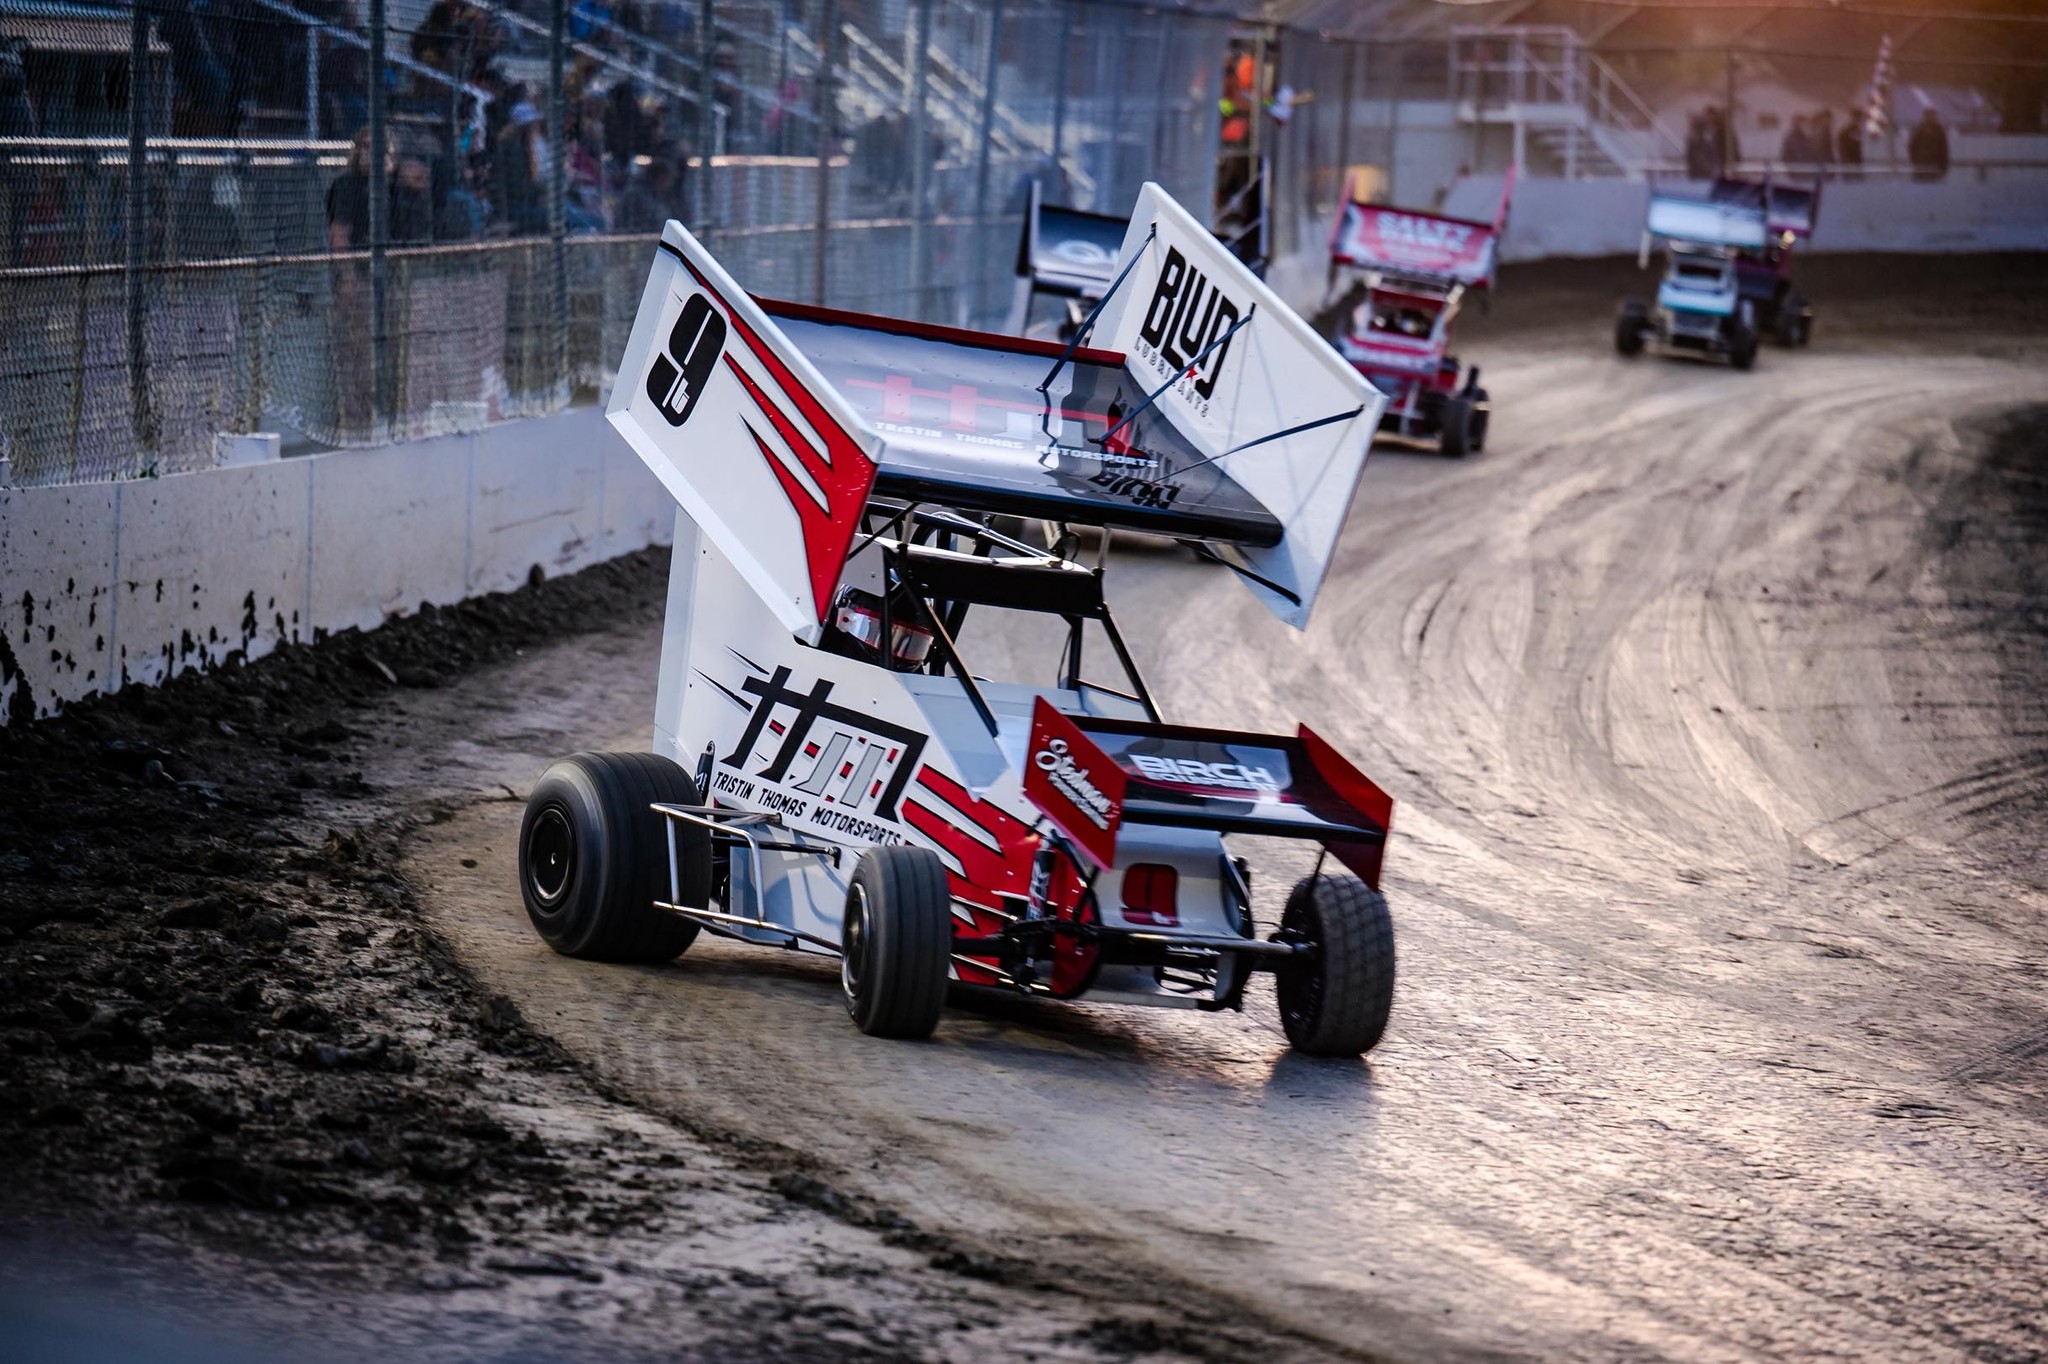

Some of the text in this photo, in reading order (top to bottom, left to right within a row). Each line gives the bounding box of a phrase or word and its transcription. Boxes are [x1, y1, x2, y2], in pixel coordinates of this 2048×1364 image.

[1140, 245, 1239, 400] BLUD
[874, 421, 943, 438] TRISTIN
[954, 432, 1026, 450] THOMAS
[1128, 754, 1277, 785] BIRCH
[713, 771, 755, 801] TRISTIN
[757, 787, 807, 818] THOMAS
[810, 805, 902, 848] MOTORSPORTS
